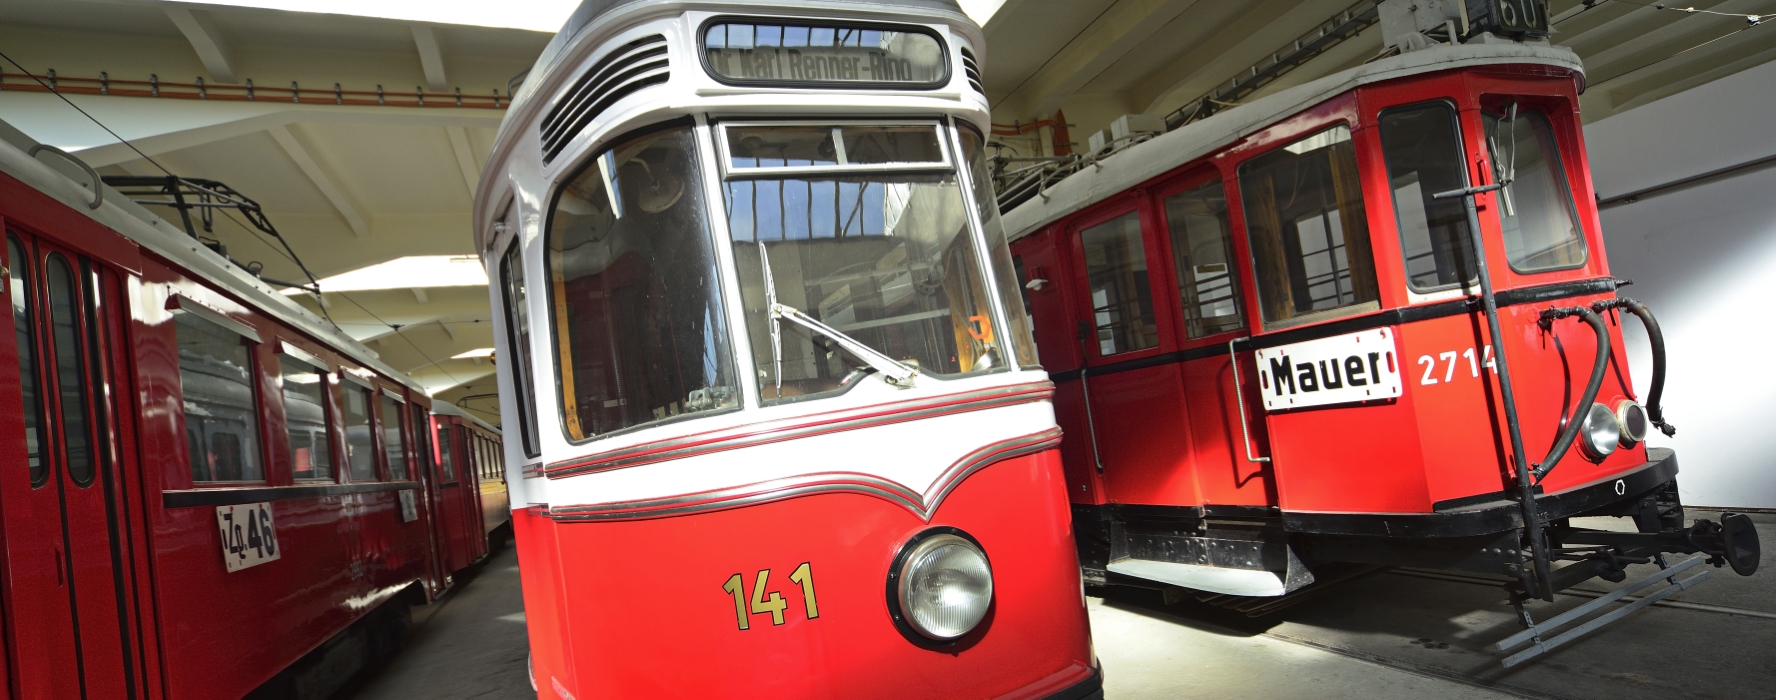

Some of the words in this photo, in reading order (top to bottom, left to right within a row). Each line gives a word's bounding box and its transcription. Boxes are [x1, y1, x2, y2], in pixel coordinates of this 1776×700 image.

[739, 49, 783, 79] Karl
[1269, 352, 1380, 396] Mauer
[1417, 345, 1499, 386] 2714
[248, 508, 275, 558] 46
[722, 561, 819, 631] 141
